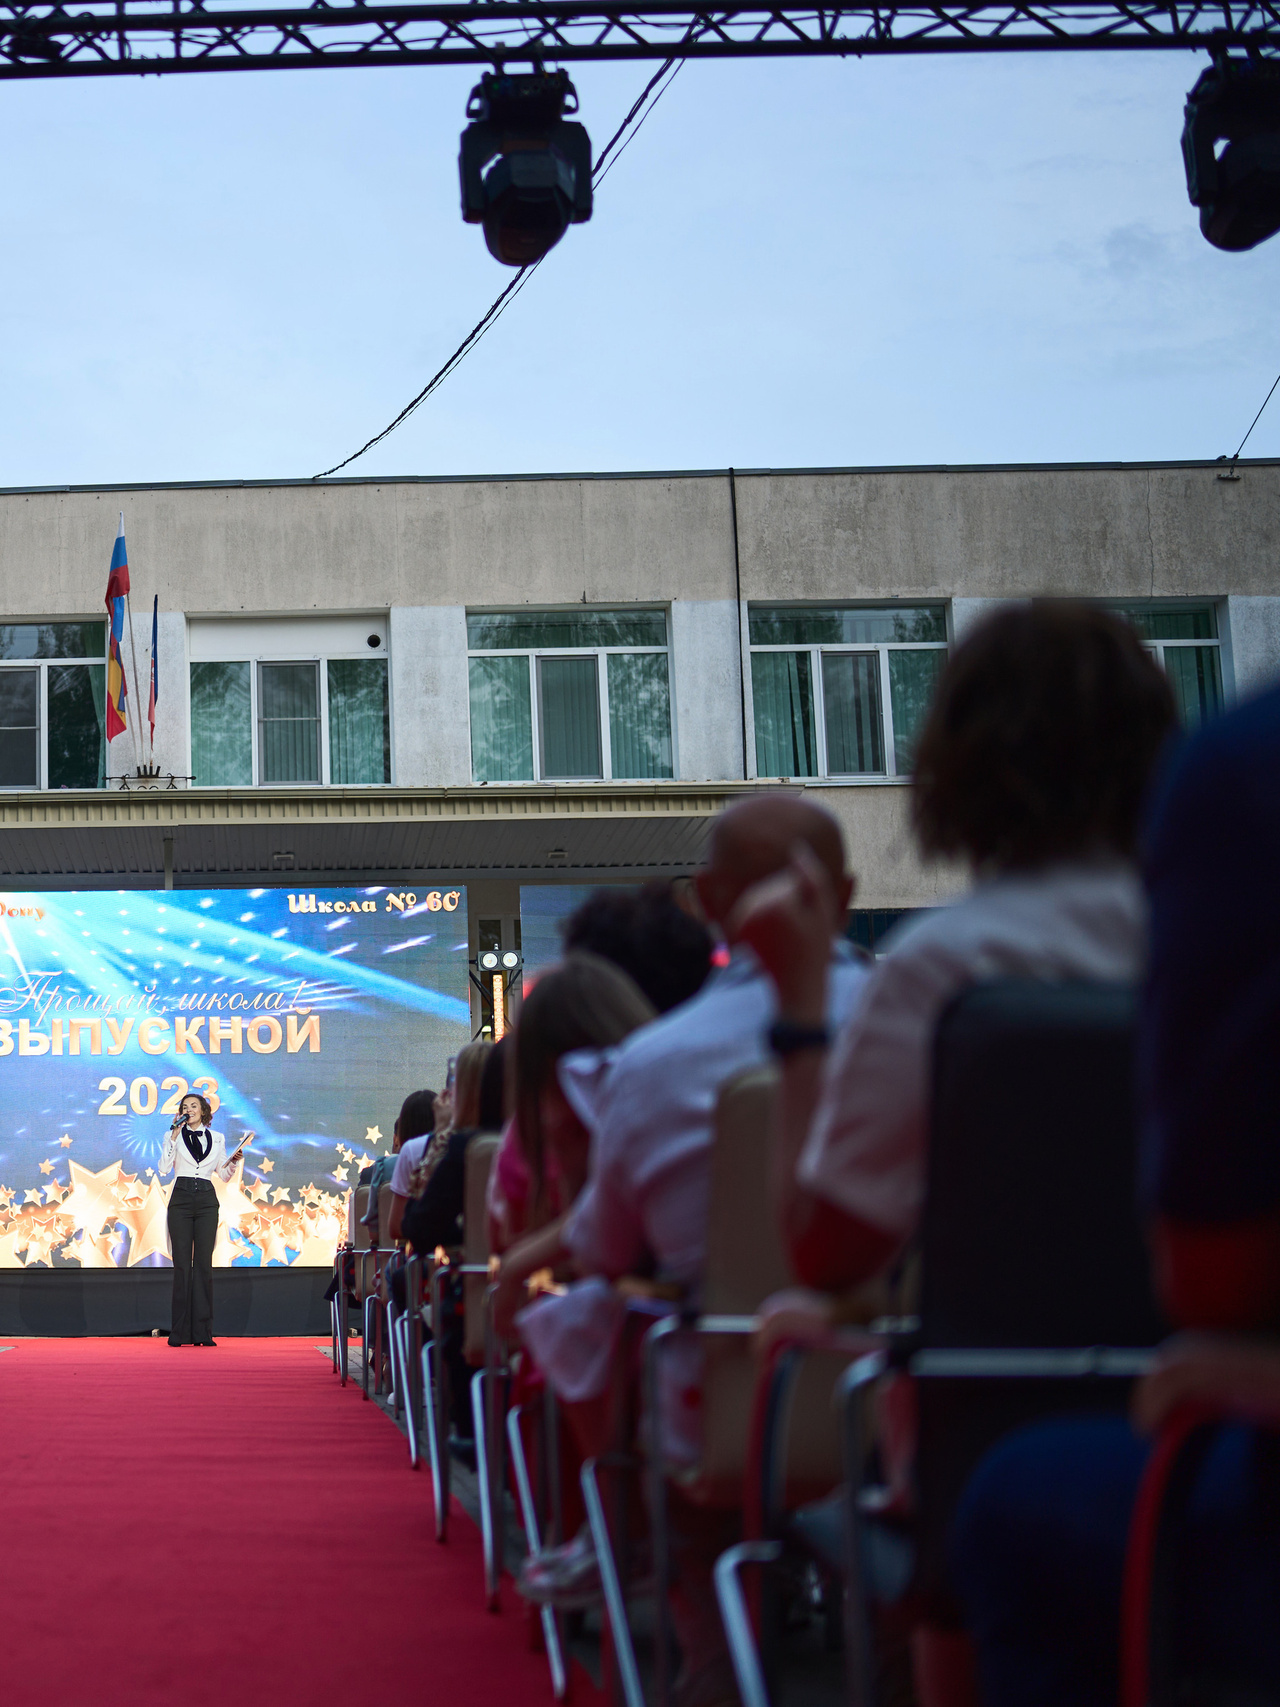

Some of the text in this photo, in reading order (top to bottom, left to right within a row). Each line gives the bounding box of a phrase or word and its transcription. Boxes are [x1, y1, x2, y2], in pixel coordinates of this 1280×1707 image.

[287, 891, 461, 914] Школа № 60
[178, 980, 308, 1012] школа!
[98, 1076, 221, 1116] 2023
